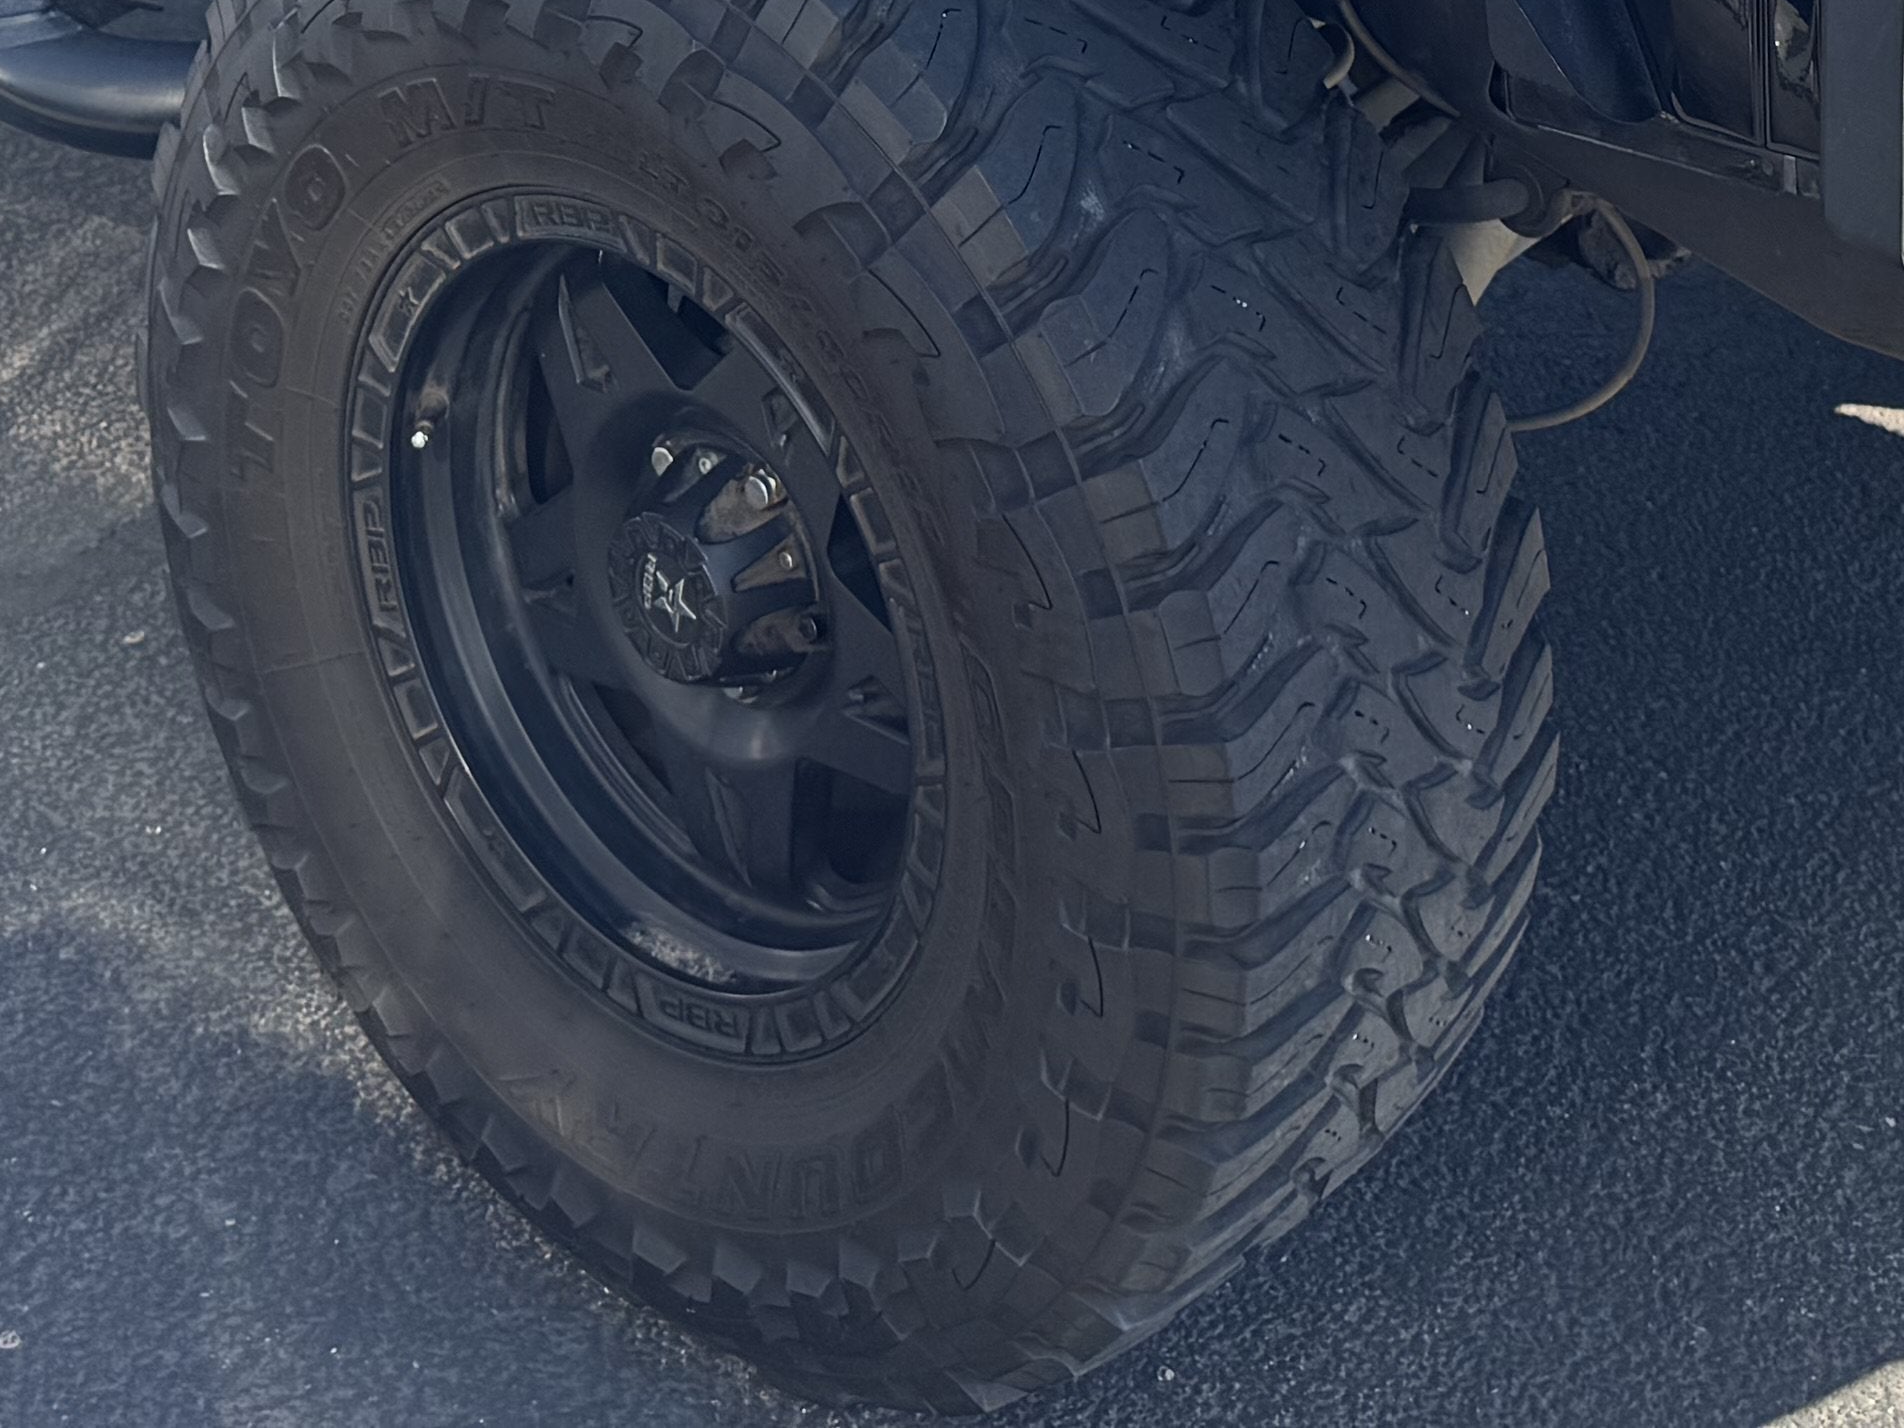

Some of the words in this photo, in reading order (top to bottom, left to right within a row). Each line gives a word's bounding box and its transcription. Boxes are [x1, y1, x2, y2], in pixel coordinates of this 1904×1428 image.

[533, 200, 612, 235] RBP
[226, 142, 348, 482] TOYO
[376, 72, 556, 148] M/T
[362, 500, 398, 614] RBP
[658, 994, 740, 1039] RBP
